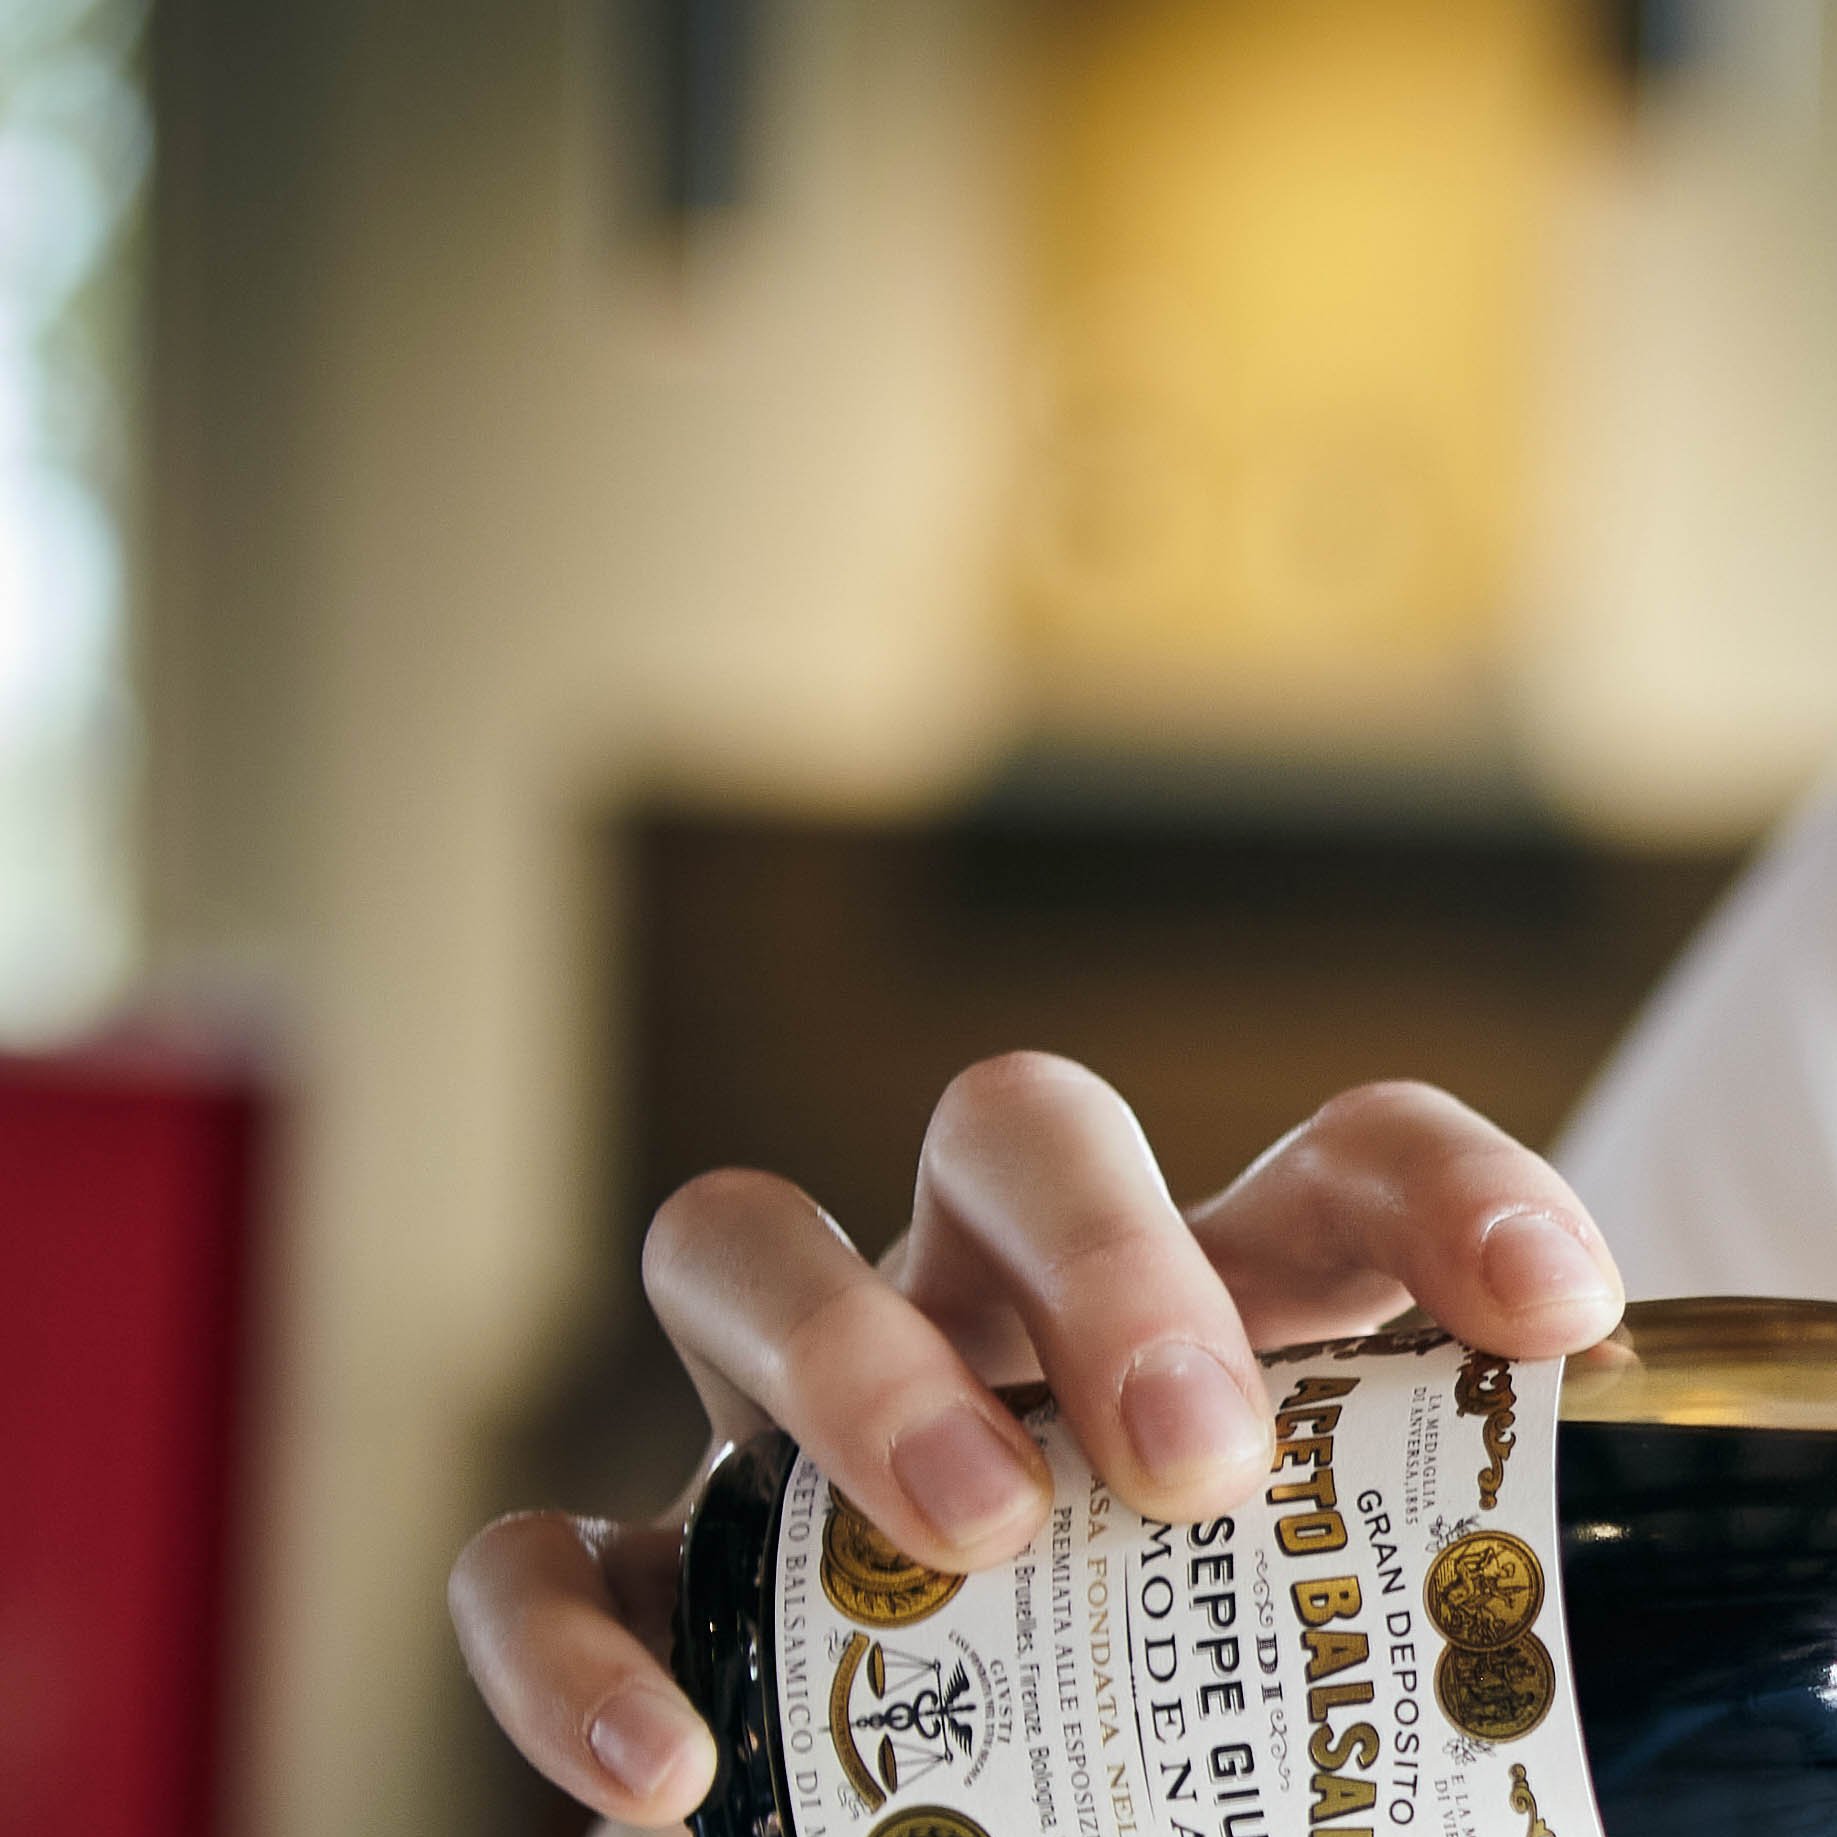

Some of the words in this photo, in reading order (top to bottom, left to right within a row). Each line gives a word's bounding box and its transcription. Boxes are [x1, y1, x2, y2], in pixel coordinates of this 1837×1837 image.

[1413, 1387, 1427, 1402] DI
[1427, 1394, 1442, 1412] LA
[1266, 1377, 1361, 1558] ACETO
[1423, 1416, 1440, 1508] MEDAGLIA
[1088, 1474, 1111, 1543] ASA
[1052, 1506, 1072, 1635] PREMIATA
[784, 1553, 813, 1753] BALSAMICO
[1088, 1555, 1120, 1749] FONDATA
[1187, 1515, 1246, 1720] SEPPE
[1056, 1643, 1079, 1713] ALLE
[1256, 1632, 1284, 1705] DI
[1356, 1489, 1407, 1596] GRAN
[1385, 1611, 1420, 1826] DEPOSITO
[990, 1659, 1013, 1745] GIVSTI
[795, 1769, 822, 1810] DI
[1434, 1779, 1452, 1803] DI
[1451, 1774, 1466, 1786] E
[1455, 1794, 1474, 1818] LA
